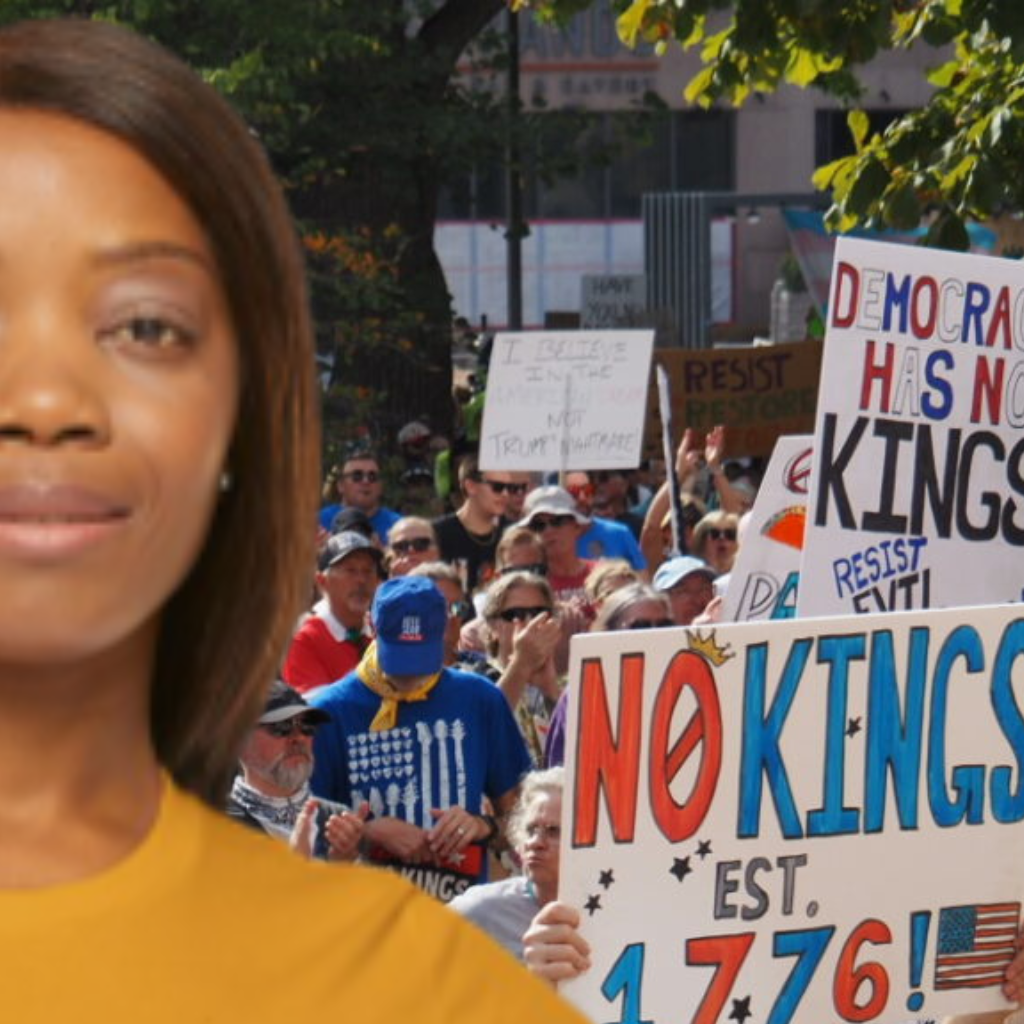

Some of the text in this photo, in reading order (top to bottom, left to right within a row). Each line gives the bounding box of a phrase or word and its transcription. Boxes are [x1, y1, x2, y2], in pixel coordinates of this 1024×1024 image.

[683, 352, 792, 394] RESIST
[859, 340, 1024, 428] HAS NO
[815, 412, 1024, 546] KINGS
[833, 537, 928, 598] RESIST
[572, 617, 1024, 849] NO KINGS
[713, 854, 818, 920] EST.
